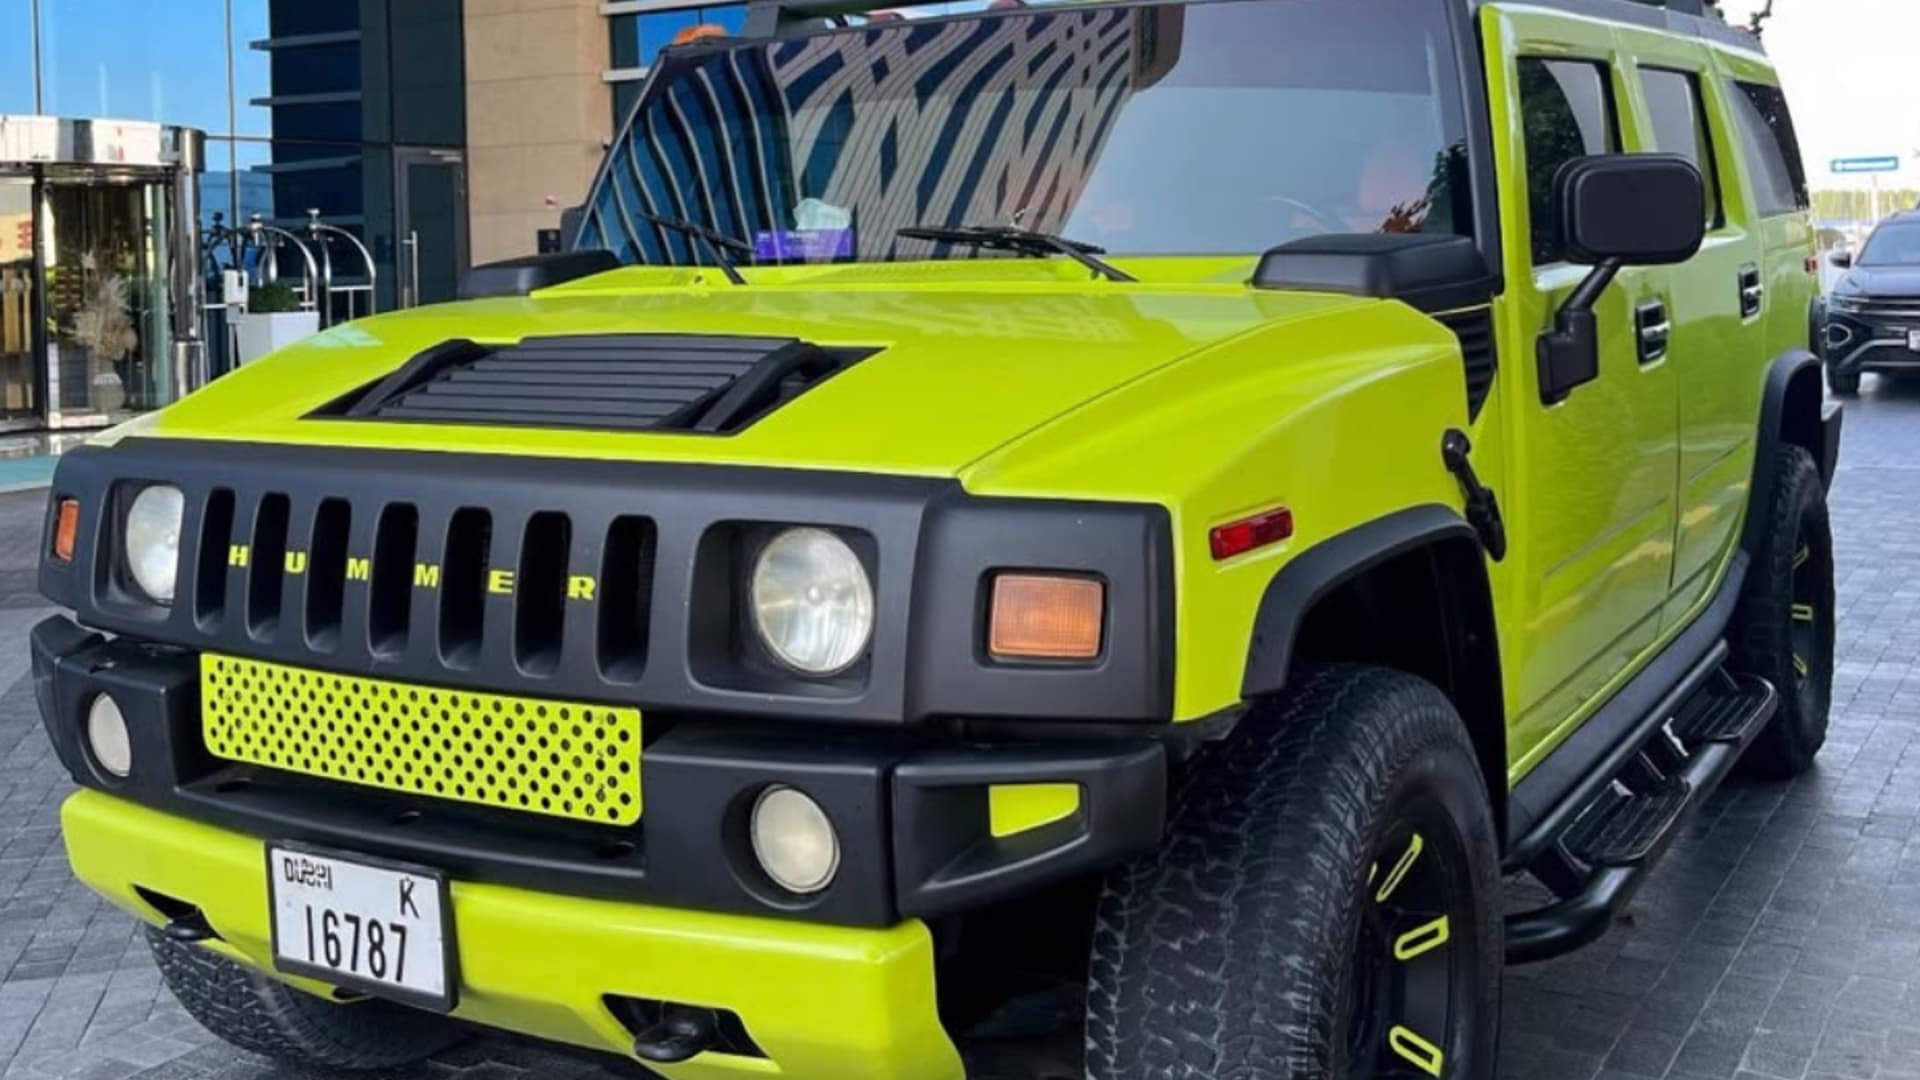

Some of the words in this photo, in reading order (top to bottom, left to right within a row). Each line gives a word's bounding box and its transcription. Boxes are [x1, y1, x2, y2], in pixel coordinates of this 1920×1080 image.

[228, 544, 597, 600] HUMMER
[400, 877, 420, 919] K
[306, 904, 407, 983] 16787
